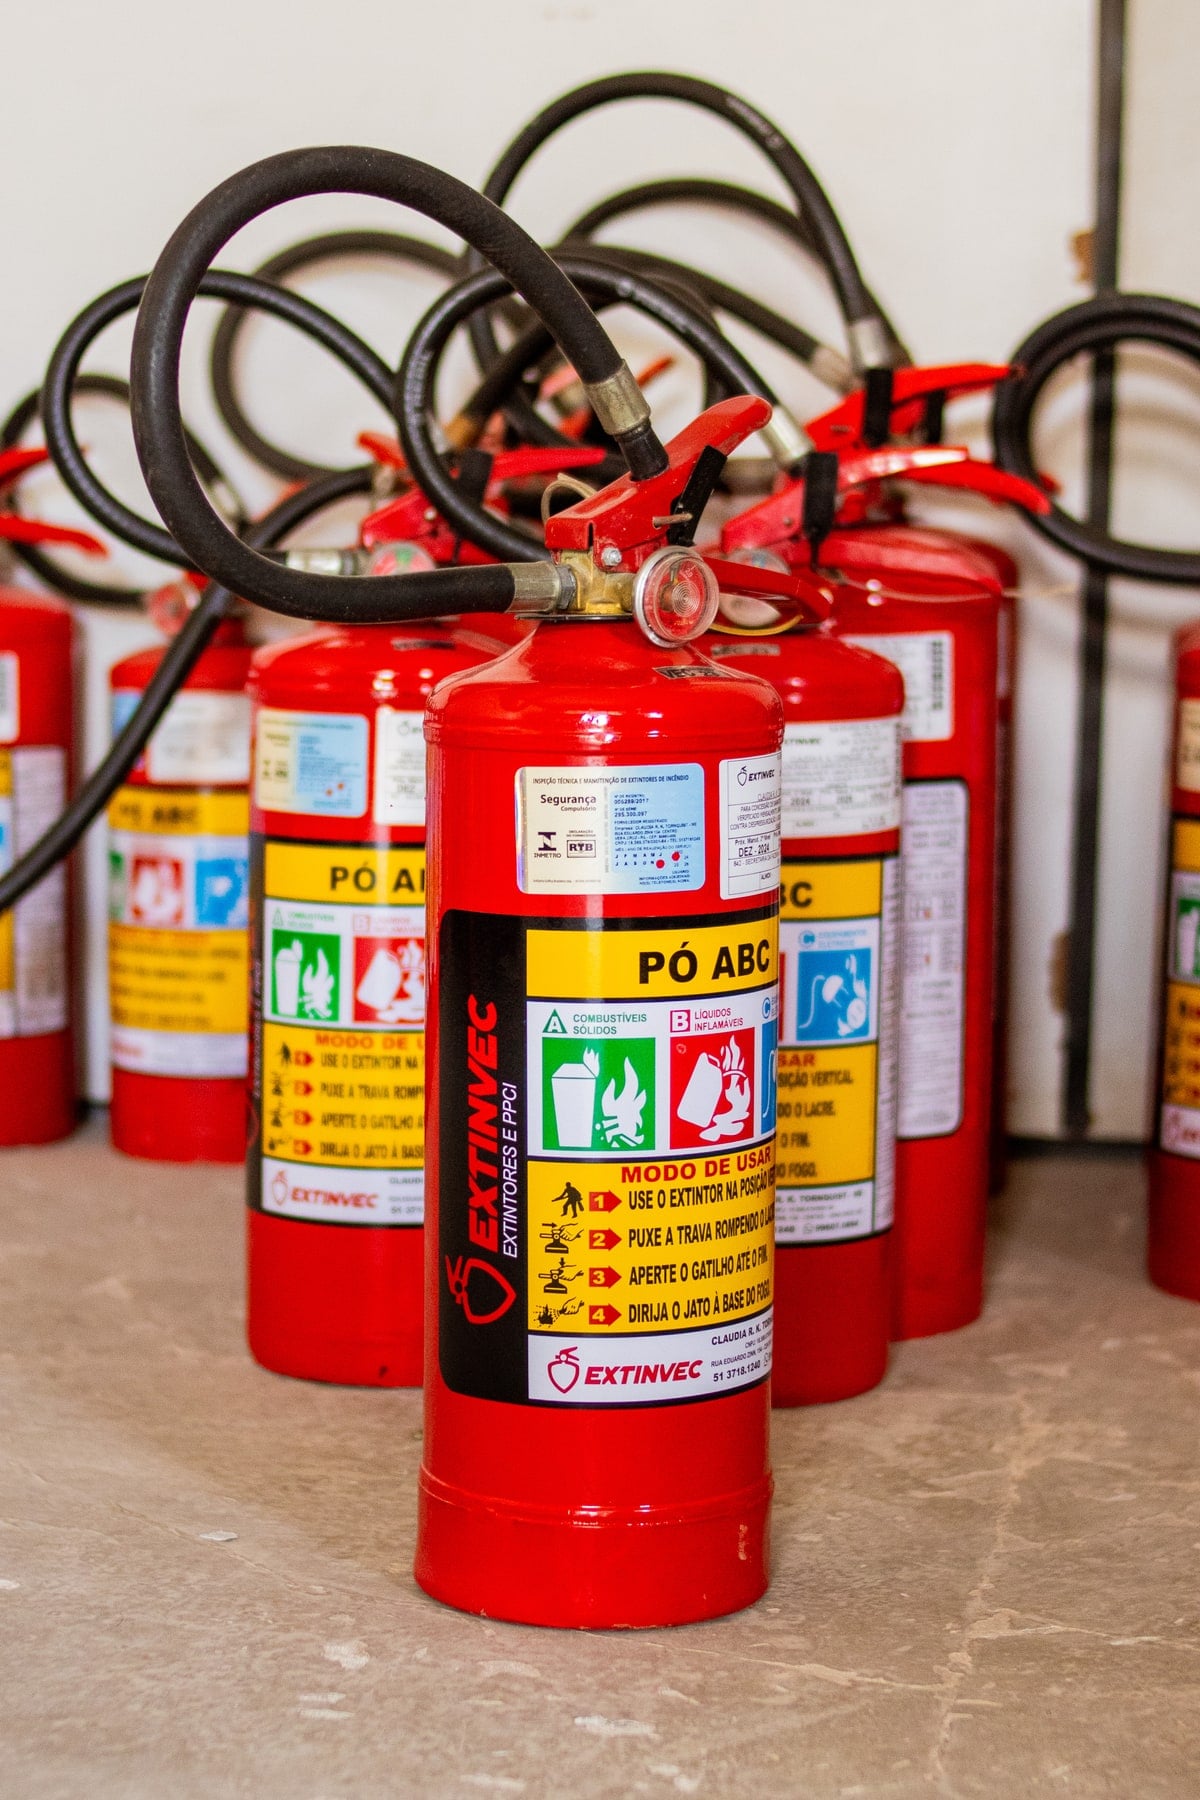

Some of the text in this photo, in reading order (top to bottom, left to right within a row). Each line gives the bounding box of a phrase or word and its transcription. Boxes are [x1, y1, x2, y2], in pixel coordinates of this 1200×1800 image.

[533, 777, 556, 785] INSPEÇÃO
[558, 776, 578, 784] TÉCNICA
[628, 776, 658, 784] EXTINTORES
[666, 774, 690, 782] INCÊNDIO
[748, 769, 775, 782] EXTINVEC
[540, 794, 596, 806] Segurança
[738, 846, 753, 858] DEZ
[330, 860, 376, 892] PÓ
[639, 938, 770, 984] PÓ ABC
[573, 1012, 648, 1022] COMBUSTÍVEIS
[671, 1010, 689, 1032] B
[694, 1008, 731, 1020] LÍQUIDOS
[694, 1018, 744, 1032] INFLAMÁVEIS
[573, 1024, 617, 1034] SÓLIDOS
[316, 1034, 407, 1050] MODO DE
[321, 1053, 338, 1068] USE
[468, 994, 498, 1252] EXTINVEC
[502, 1082, 518, 1258] EXTINTORES E PPCI
[621, 1146, 770, 1183] MODO DE USAR
[291, 1186, 378, 1209] EXTINVEC
[594, 1168, 767, 1210] 1 USE O EXTINTOR NA POSIÇÃO
[592, 1232, 606, 1246] 2
[628, 1227, 662, 1248] PUXE
[665, 1226, 674, 1246] A
[677, 1222, 712, 1244] TRAVA
[716, 1211, 758, 1240] ROMPENDO
[592, 1270, 606, 1284] 3
[629, 1264, 676, 1286] APERTE
[680, 1262, 688, 1282] O
[692, 1255, 734, 1280] GATILHO
[736, 1246, 750, 1272] ATÉ
[752, 1248, 756, 1268] O
[592, 1308, 606, 1322] 4
[628, 1302, 668, 1323] DIRIJA
[672, 1300, 680, 1320] O
[684, 1297, 710, 1319] JATO
[713, 1291, 720, 1315] À
[722, 1290, 744, 1312] BASE
[746, 1286, 756, 1307] DO
[712, 1330, 746, 1346] CLAUDIA
[748, 1327, 754, 1336] R.
[756, 1324, 762, 1333] K.
[711, 1360, 722, 1368] RUA
[724, 1352, 746, 1364] EDUARDO
[714, 1360, 760, 1382] 51 3718.1240
[584, 1359, 704, 1385] EXTINVEC
